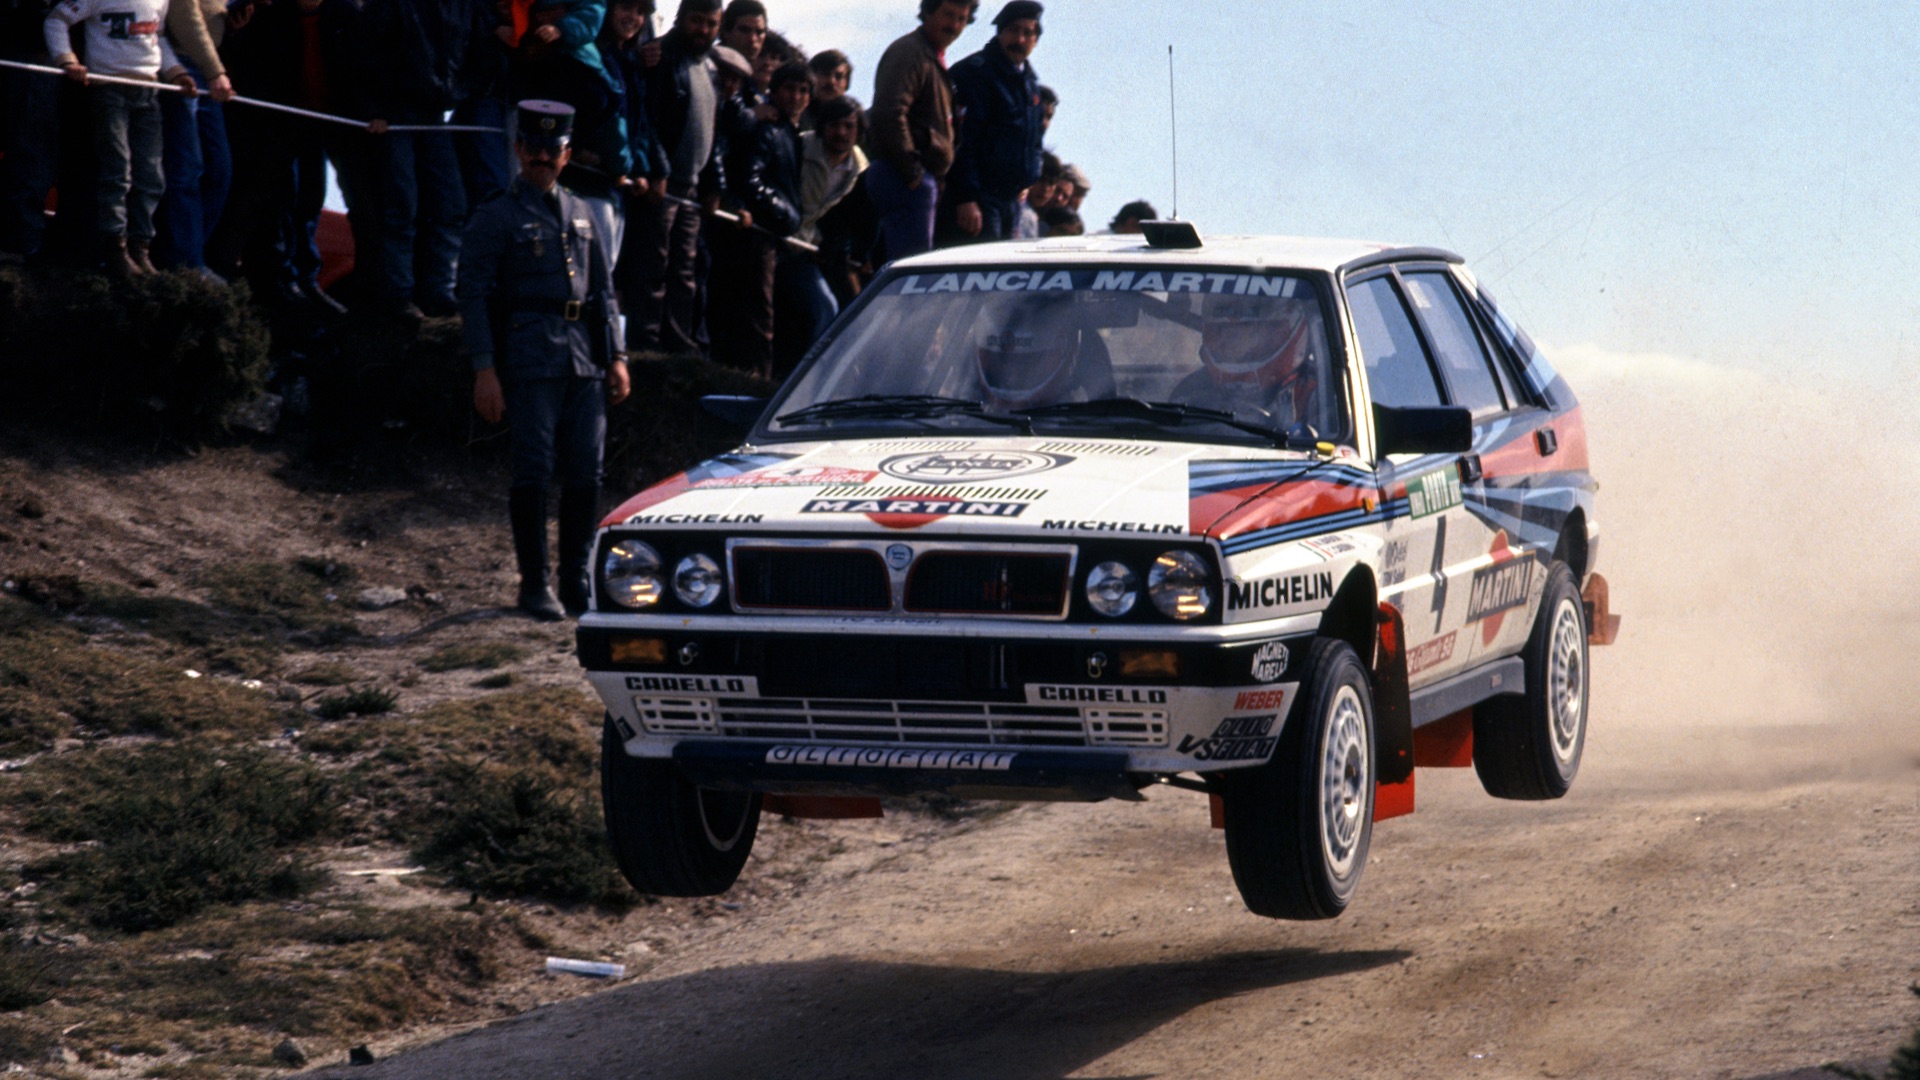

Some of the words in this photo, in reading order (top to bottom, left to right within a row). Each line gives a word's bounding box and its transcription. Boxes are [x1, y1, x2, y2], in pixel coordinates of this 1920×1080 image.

[901, 270, 1075, 295] LANCIA
[1091, 270, 1299, 298] MARTINI
[809, 500, 1020, 516] MARTINI
[630, 513, 764, 524] MICHELIN
[1041, 519, 1183, 534] MICHELIN
[1226, 571, 1334, 610] MICHELIN
[1469, 560, 1532, 617] MARTINI
[624, 676, 745, 692] CARELLO
[1038, 686, 1167, 704] CARELLO
[1233, 690, 1284, 710] WEBER
[1214, 716, 1274, 737] OLIO
[1214, 738, 1274, 760] FIAT
